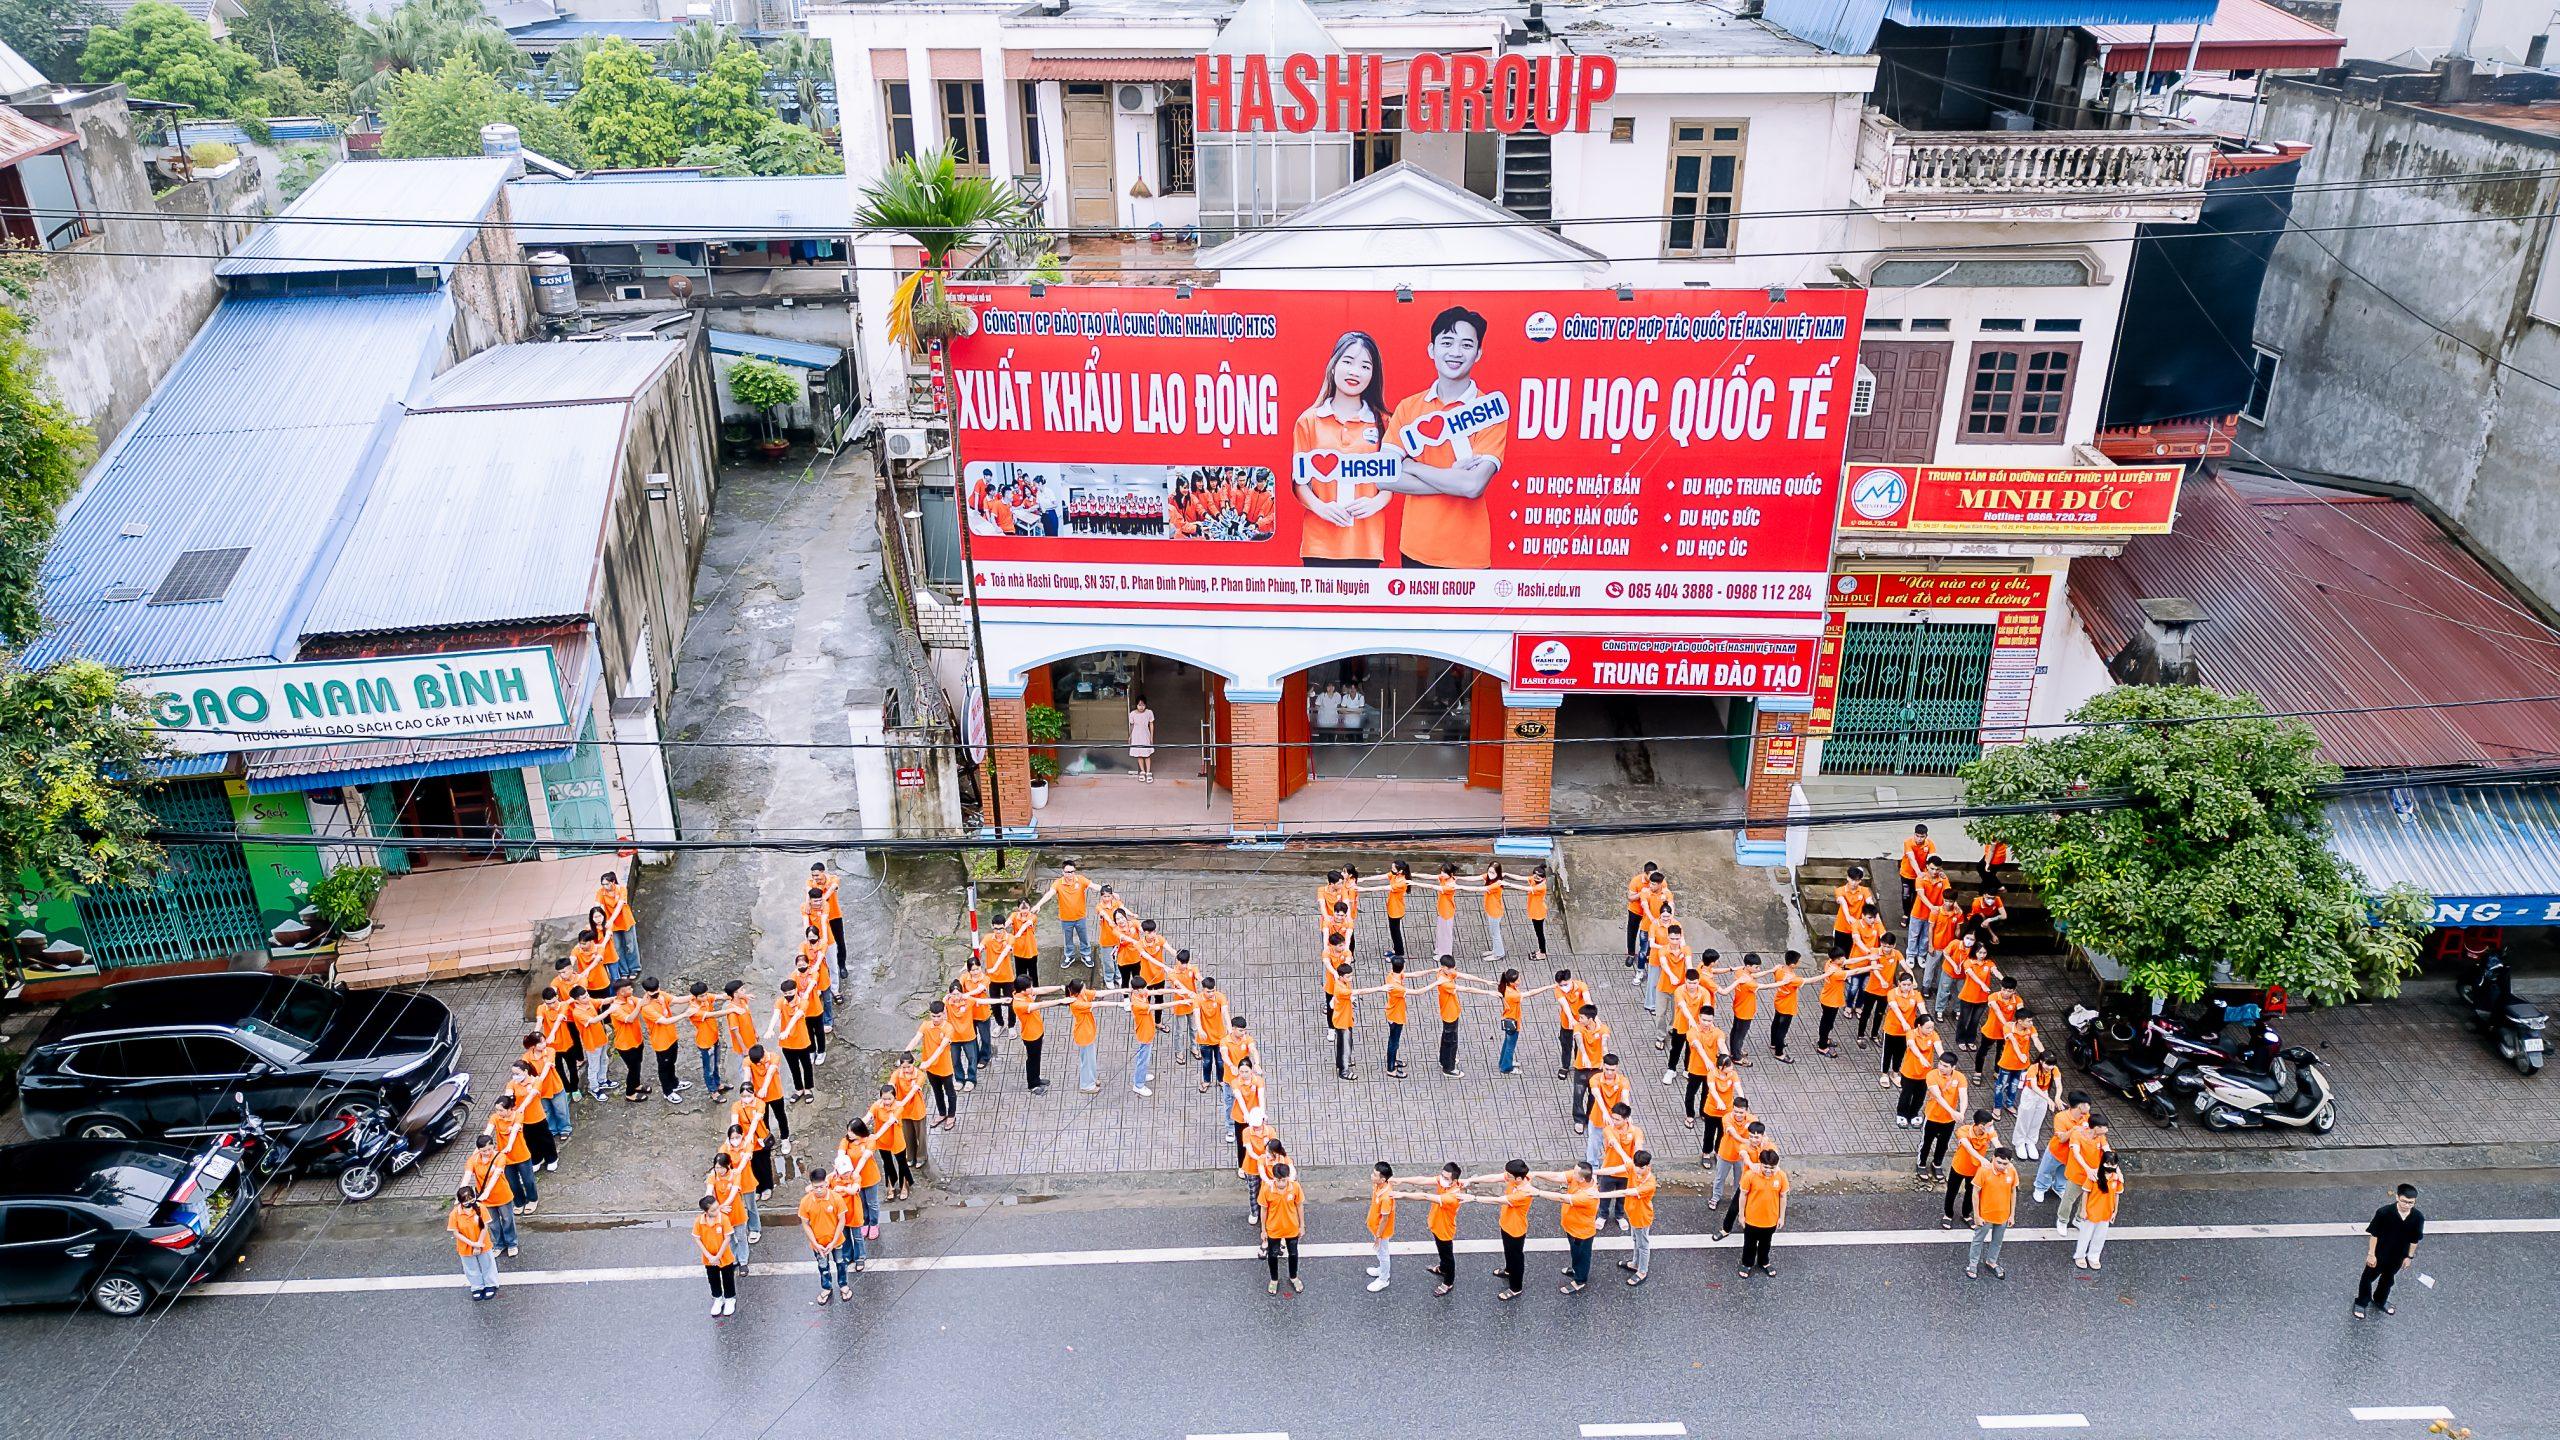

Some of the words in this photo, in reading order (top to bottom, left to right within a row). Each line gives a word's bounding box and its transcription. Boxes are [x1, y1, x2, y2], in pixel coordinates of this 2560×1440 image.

[1194, 52, 1382, 134] HASHI
[1406, 51, 1618, 135] GROUP
[984, 309, 1016, 333] CÔNG
[1019, 313, 1032, 333] TY
[1036, 313, 1050, 333] CP
[1054, 309, 1077, 333] ĐÀO
[1080, 313, 1101, 339] TẠO
[1105, 309, 1121, 333] VÀ
[1123, 315, 1155, 335] CUNG
[1158, 311, 1182, 335] ỨNG
[1186, 311, 1218, 336] NHÂN
[1221, 314, 1243, 341] LỰC
[1246, 317, 1275, 336] HTCS
[1564, 314, 1597, 338] CÔNG
[1601, 319, 1615, 338] TY
[1618, 319, 1635, 338] CP
[1638, 316, 1663, 342] HỢP
[1666, 314, 1689, 338] TÁC
[1692, 311, 1725, 340] QUỐC
[1729, 311, 1746, 338] TẾ
[1746, 319, 1783, 338] HASHI
[1786, 314, 1814, 342] VIỆT
[1815, 319, 1845, 338] NAM
[954, 347, 1033, 431] XUẤT
[1043, 345, 1123, 434] KHẨU
[1131, 372, 1186, 434] LAO
[1194, 361, 1278, 448] ĐỘNG
[1518, 377, 1573, 441] DU
[1579, 378, 1660, 454] HỌC
[1668, 354, 1776, 448] QUỐC
[1788, 355, 1841, 440] TẾ
[1406, 430, 1417, 450] I
[1447, 398, 1504, 434] HASHI
[1299, 457, 1305, 478] I
[1341, 458, 1395, 477] HASHI
[1928, 471, 1961, 481] TRUNG
[1964, 470, 1986, 481] TÂM
[1989, 470, 2006, 482] BỒI
[2047, 471, 2072, 482] KIẾN
[2075, 471, 2101, 482] THỨC
[2104, 471, 2117, 482] VÀ
[2119, 472, 2152, 484] LUYỆN
[2155, 472, 2171, 482] THI
[1527, 477, 1544, 494] DU
[1547, 477, 1573, 498] HỌC
[1576, 474, 1611, 498] NHẬT
[1613, 472, 1641, 494] BẢN
[1682, 478, 1702, 495] DU
[1705, 478, 1733, 498] HỌC
[1737, 478, 1782, 495] TRUNG
[1784, 472, 1822, 497] QUỐC
[1956, 489, 2055, 509] MINH
[2060, 484, 2134, 510] ĐỨC
[1524, 508, 1542, 524] DU
[1545, 508, 1571, 528] HỌC
[1574, 505, 1601, 525] HÀN
[1604, 503, 1639, 527] QUỐC
[1679, 510, 1698, 526] DU
[1701, 510, 1729, 529] HỌC
[1732, 506, 1760, 526] ĐỨC
[1984, 512, 2024, 521] Hotline:
[2026, 512, 2098, 522] 0866.720.726
[1523, 538, 1540, 555] DU
[1543, 538, 1569, 558] HỌC
[1571, 535, 1593, 555] ĐÀI
[1596, 539, 1630, 555] LOAN
[1676, 539, 1695, 556] DU
[1698, 540, 1726, 559] HỌC
[1729, 537, 1748, 556] ÚC
[1008, 572, 1024, 587] nhà
[1026, 573, 1051, 588] Hashi
[1054, 573, 1082, 591] Group,
[1085, 575, 1097, 589] SN
[1100, 575, 1118, 591] 357,
[1132, 576, 1154, 590] Phan
[1179, 576, 1209, 593] Phùng,
[1211, 577, 1219, 591] P.
[1221, 577, 1243, 592] Phan
[1268, 577, 1298, 594] Phùng,
[1301, 578, 1313, 593] TP.
[1315, 578, 1333, 594] Thái
[1336, 579, 1370, 596] Nguyên
[1409, 580, 1439, 595] HASHI
[1442, 580, 1475, 595] GROUP
[1517, 582, 1581, 597] Hashi.edu.vn
[1628, 583, 1651, 598] 085
[1655, 583, 1678, 598] 404
[1682, 584, 1713, 599] 3888
[1726, 584, 1757, 600] 0988
[1762, 584, 1785, 600] 112
[1788, 584, 1811, 600] 284
[1939, 579, 1965, 589] nào
[1970, 578, 1986, 589] có
[1991, 578, 2001, 591] ý
[2004, 577, 2031, 590] chí,
[1885, 594, 1909, 603] nơi
[1912, 591, 1931, 604] đó
[1936, 594, 1951, 604] có
[1955, 596, 1981, 604] con
[1604, 640, 1626, 650] CÔNG
[1629, 642, 1638, 650] TY
[1640, 642, 1651, 650] CP
[1654, 641, 1671, 652] HỢP
[1673, 641, 1689, 651] TÁC
[1691, 640, 1713, 652] QUỐC
[1716, 641, 1728, 651] TẾ
[1728, 643, 1753, 652] HASHI
[1755, 642, 1774, 654] VIỆT
[1775, 644, 1796, 652] NAM
[1521, 677, 1546, 685] HASHI
[1547, 677, 1577, 685] GROUP
[1592, 661, 1659, 685] TRUNG
[1665, 659, 1709, 685] TÂM
[1714, 659, 1757, 686] ĐÀO
[1763, 664, 1802, 692] TẠO
[150, 685, 269, 735] GẠO
[284, 676, 401, 719] NAM
[414, 663, 529, 710] BÌNH
[357, 721, 392, 735] SẠCH
[395, 719, 422, 730] CAO
[425, 714, 450, 728] CẤP
[476, 711, 502, 724] VIỆT
[506, 710, 534, 721] NAM
[1521, 724, 1541, 733] 357
[1777, 723, 1790, 731] 357
